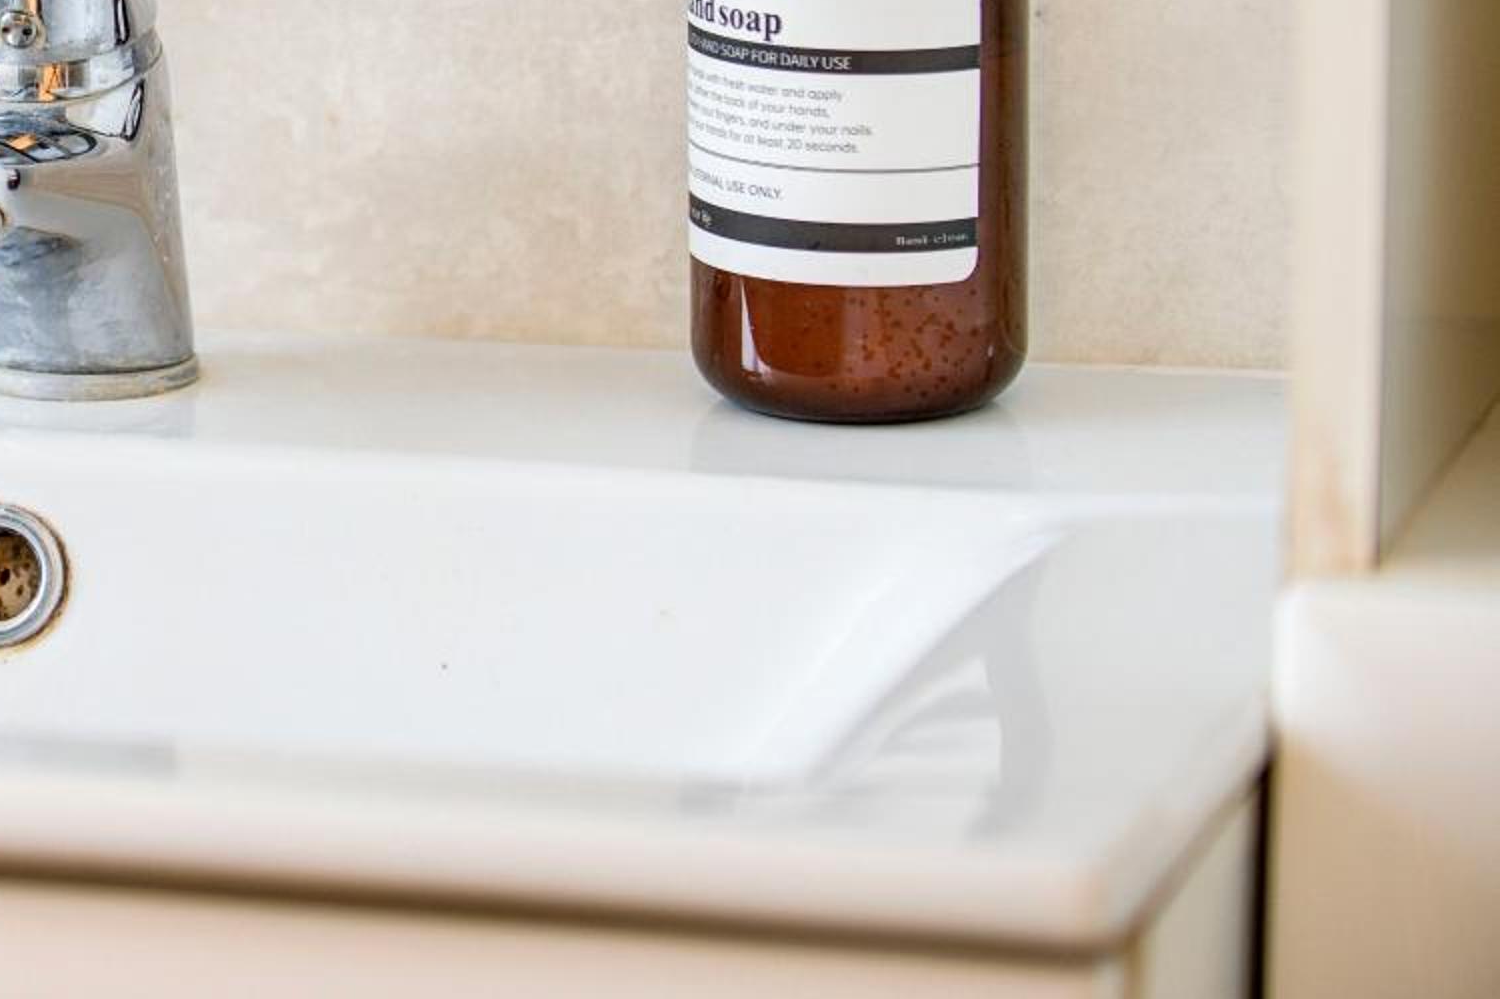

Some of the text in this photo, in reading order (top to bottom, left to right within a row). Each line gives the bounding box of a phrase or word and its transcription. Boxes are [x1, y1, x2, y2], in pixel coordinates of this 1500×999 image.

[718, 4, 783, 42] soap
[720, 43, 750, 61] SOAP
[751, 48, 778, 65] FOR
[780, 51, 820, 68] DAILY
[821, 56, 852, 70] USE
[780, 86, 805, 99] and
[807, 88, 843, 102] apply
[809, 124, 837, 137] your
